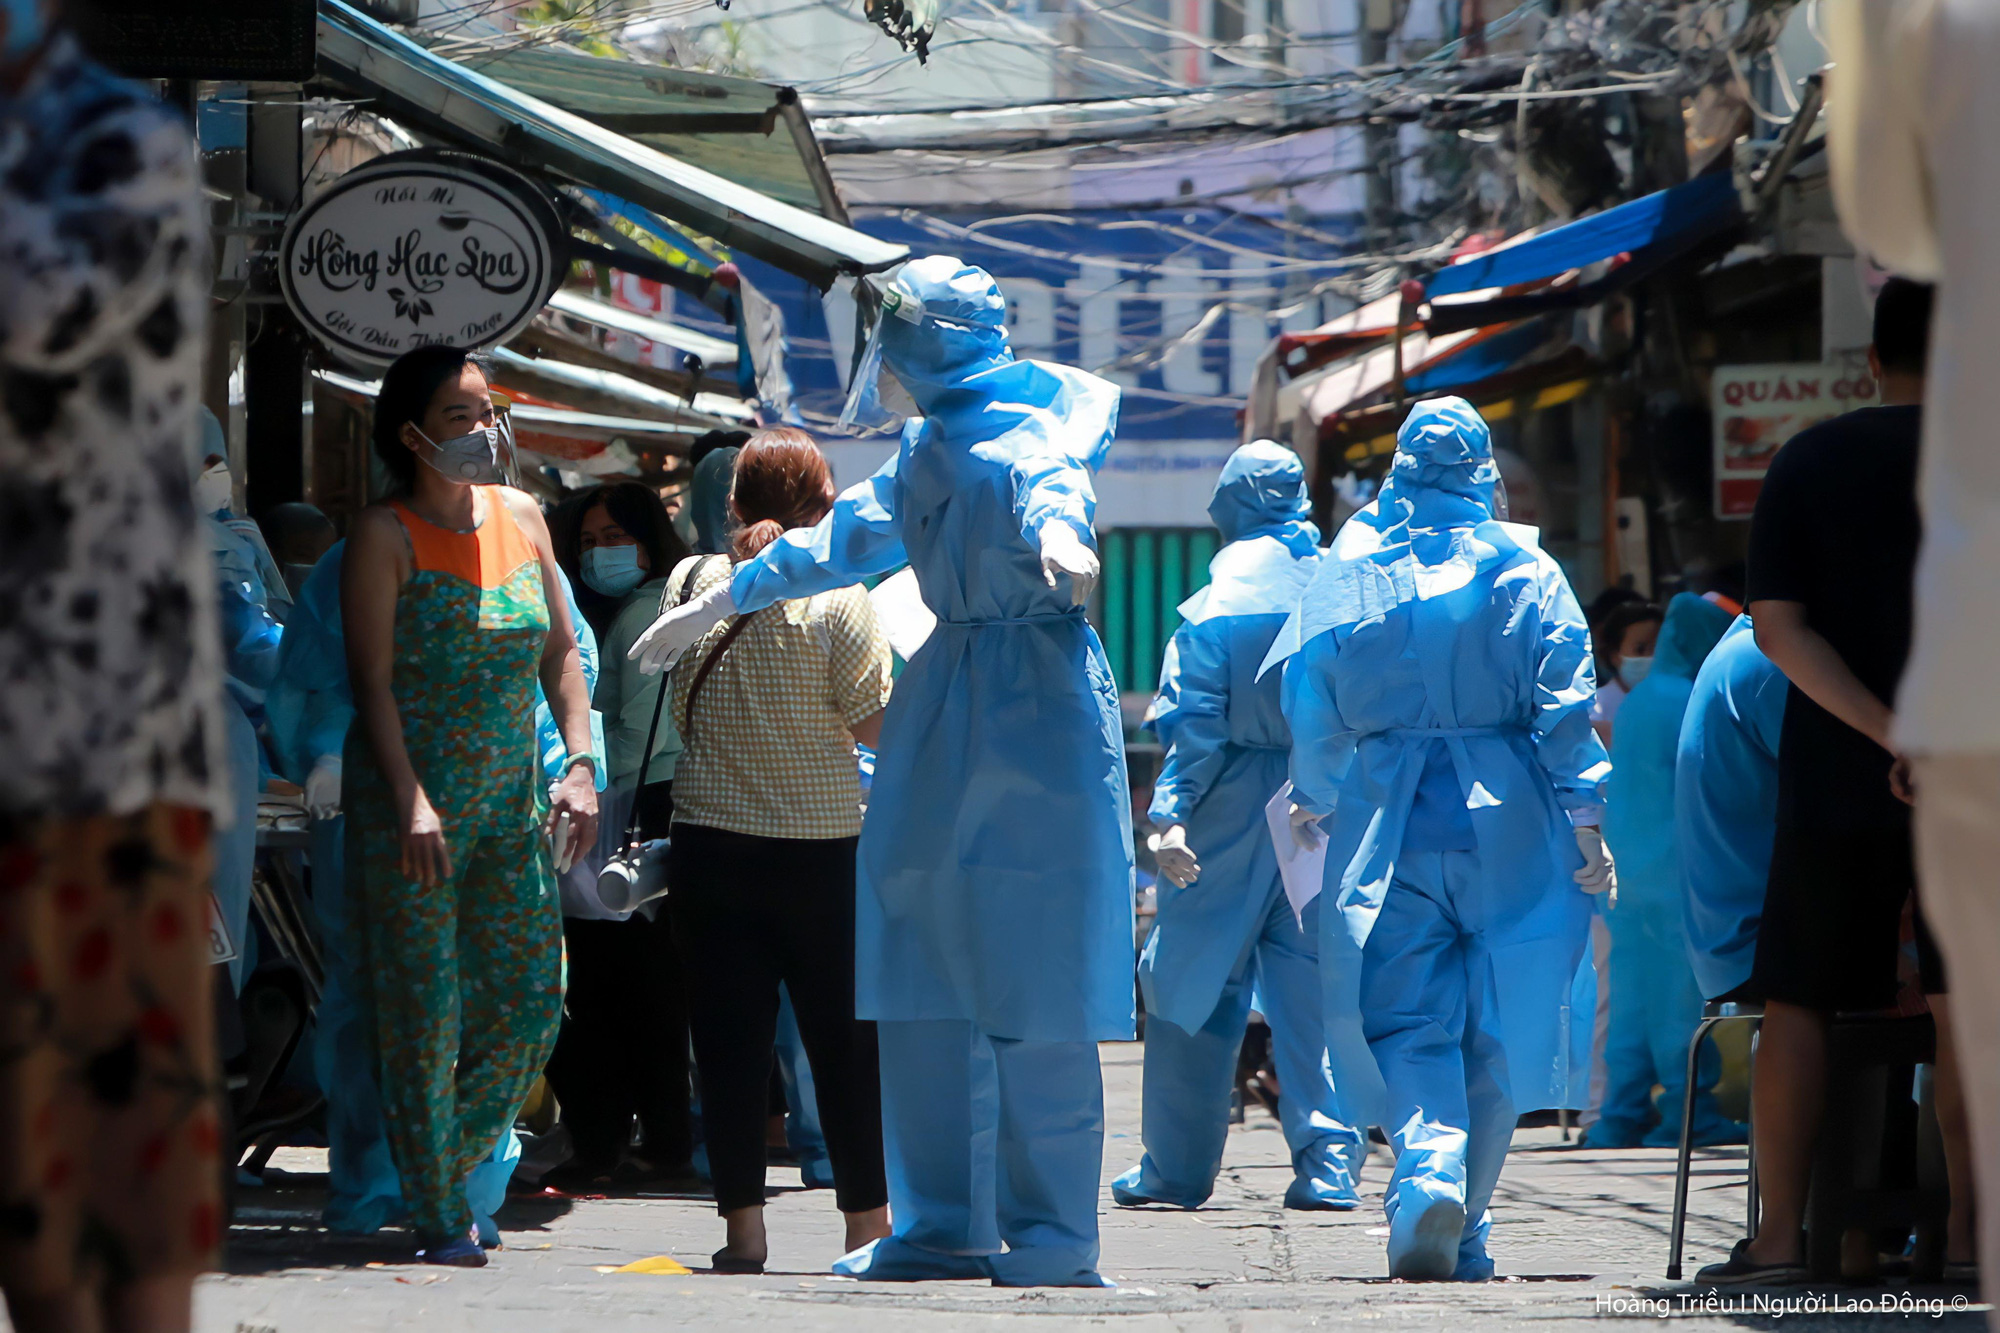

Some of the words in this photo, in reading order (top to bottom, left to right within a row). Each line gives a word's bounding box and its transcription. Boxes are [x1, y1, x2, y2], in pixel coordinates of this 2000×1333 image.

[299, 229, 379, 291] Hồng
[387, 229, 449, 293] Hạc
[455, 236, 522, 290] Spa
[1723, 376, 1820, 406] QUÁN
